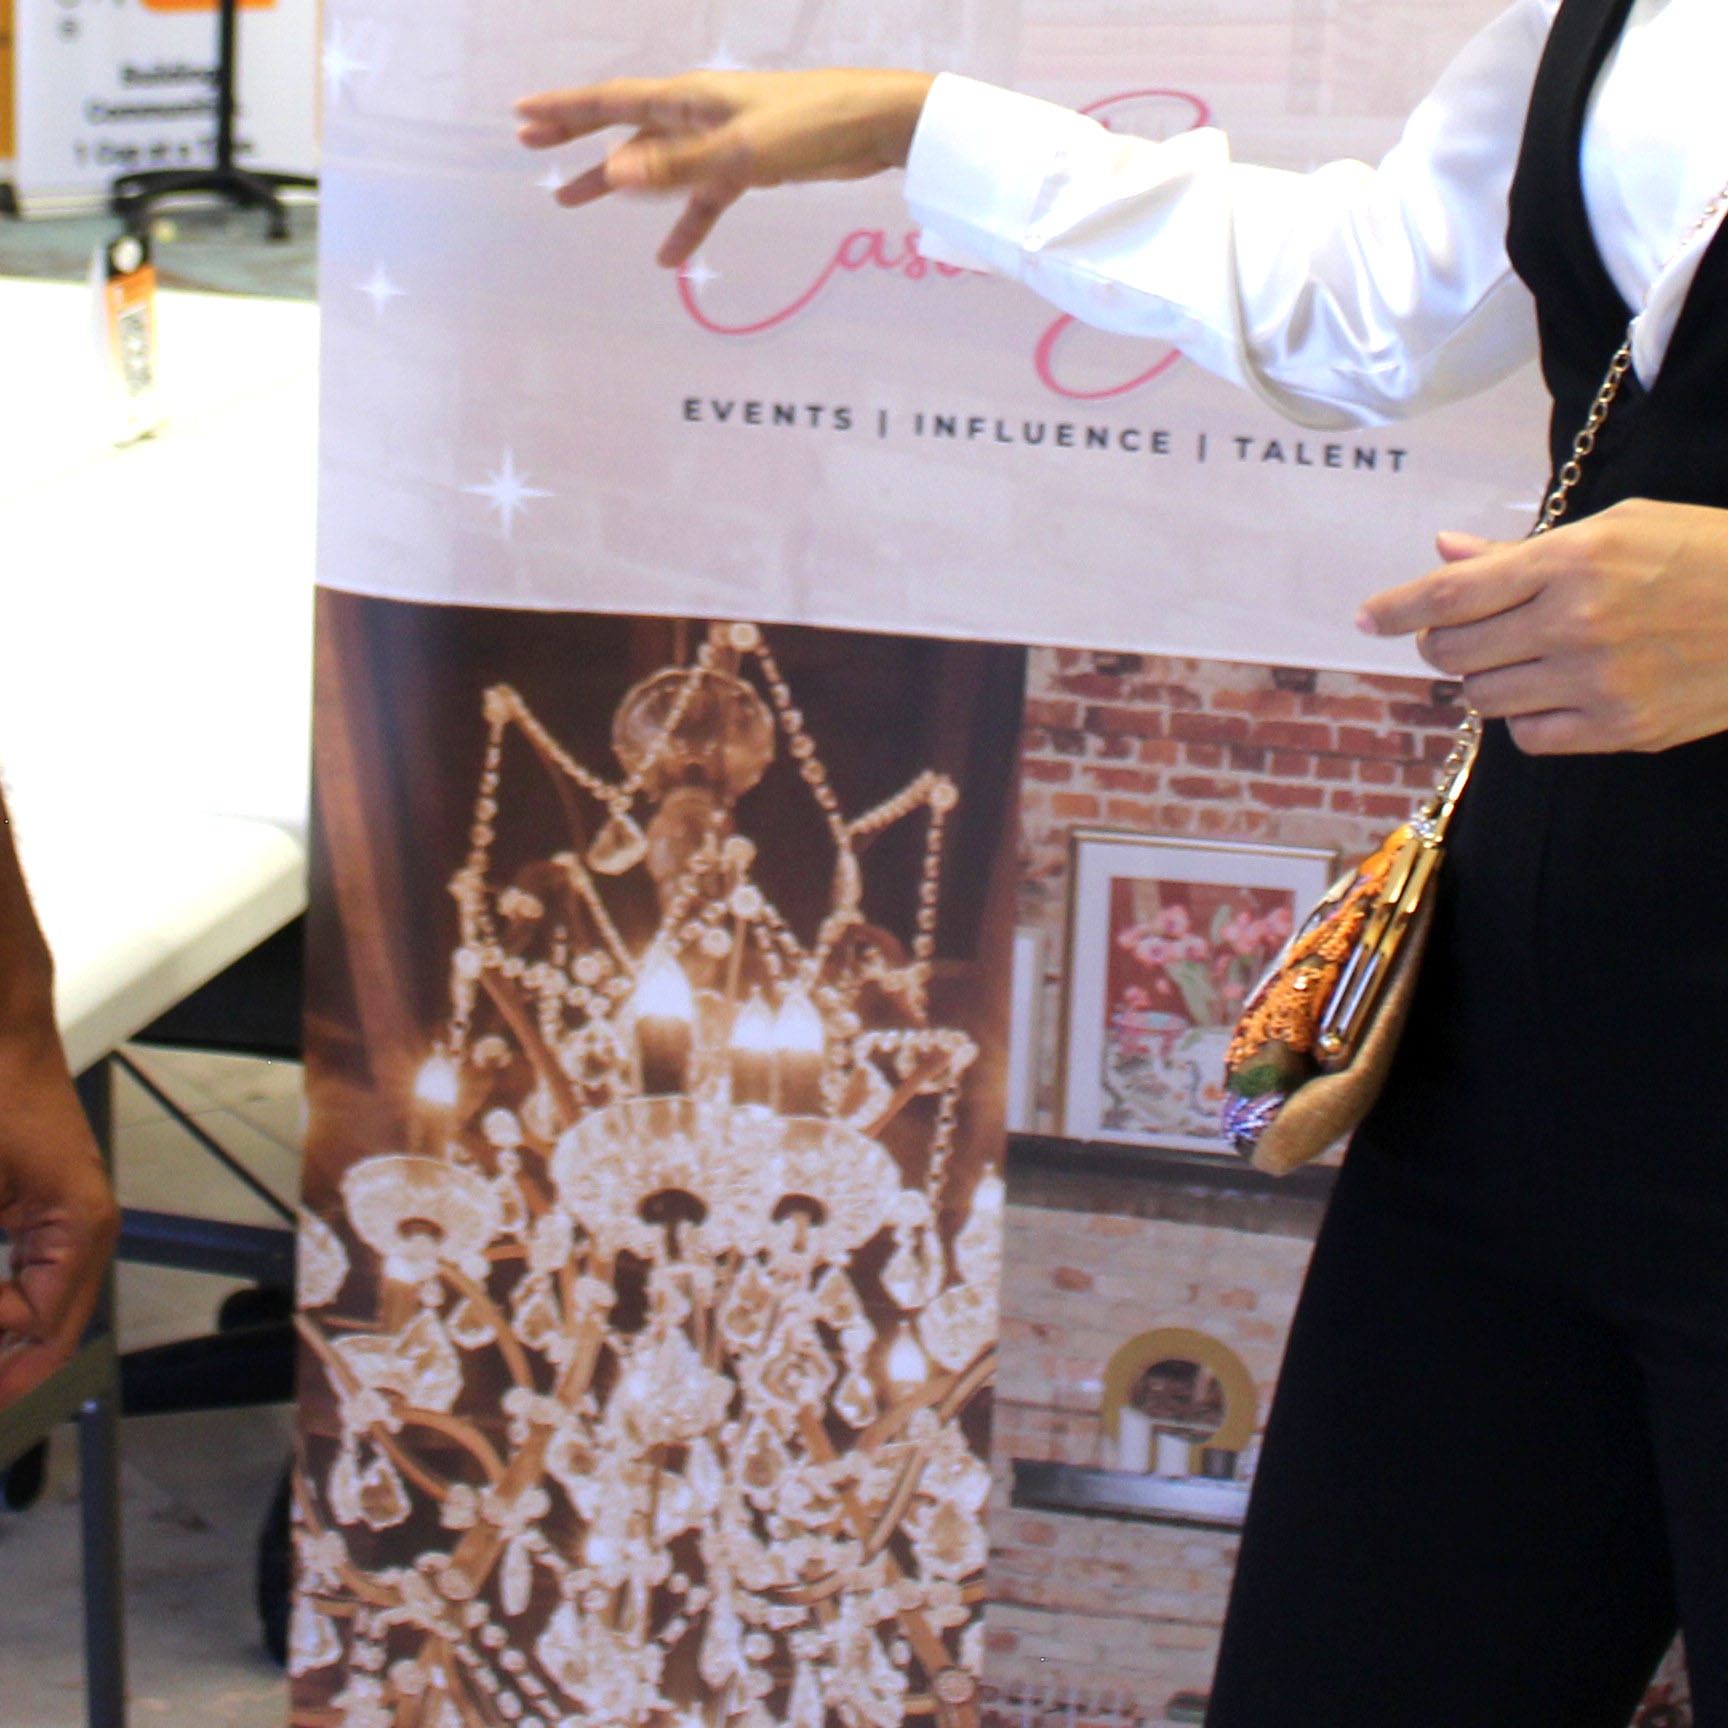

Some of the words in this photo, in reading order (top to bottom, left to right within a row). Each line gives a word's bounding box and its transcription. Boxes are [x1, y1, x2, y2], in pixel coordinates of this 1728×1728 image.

[682, 397, 854, 431] EVENTS
[913, 412, 1173, 454] INFLUENCE
[1234, 436, 1411, 474] TALENT
